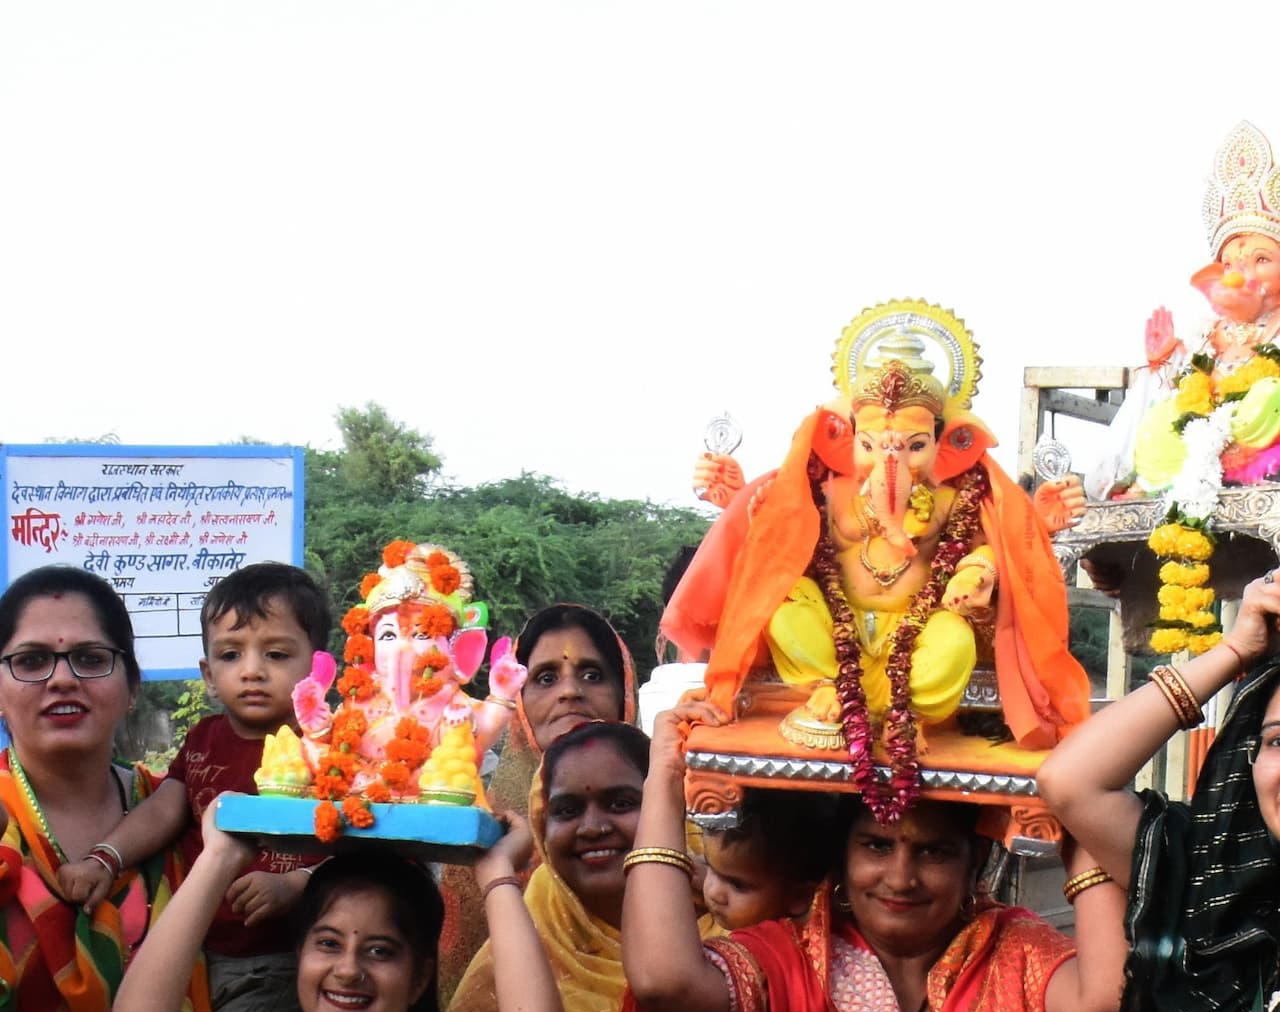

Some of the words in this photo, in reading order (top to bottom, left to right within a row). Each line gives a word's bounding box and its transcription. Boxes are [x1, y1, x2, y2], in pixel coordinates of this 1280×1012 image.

[11, 481, 54, 504] देवस्थान
[87, 485, 113, 503] द्वारा
[84, 549, 111, 572] देवी
[114, 554, 147, 576] कुण्ड
[192, 547, 246, 570] बीकानेर
